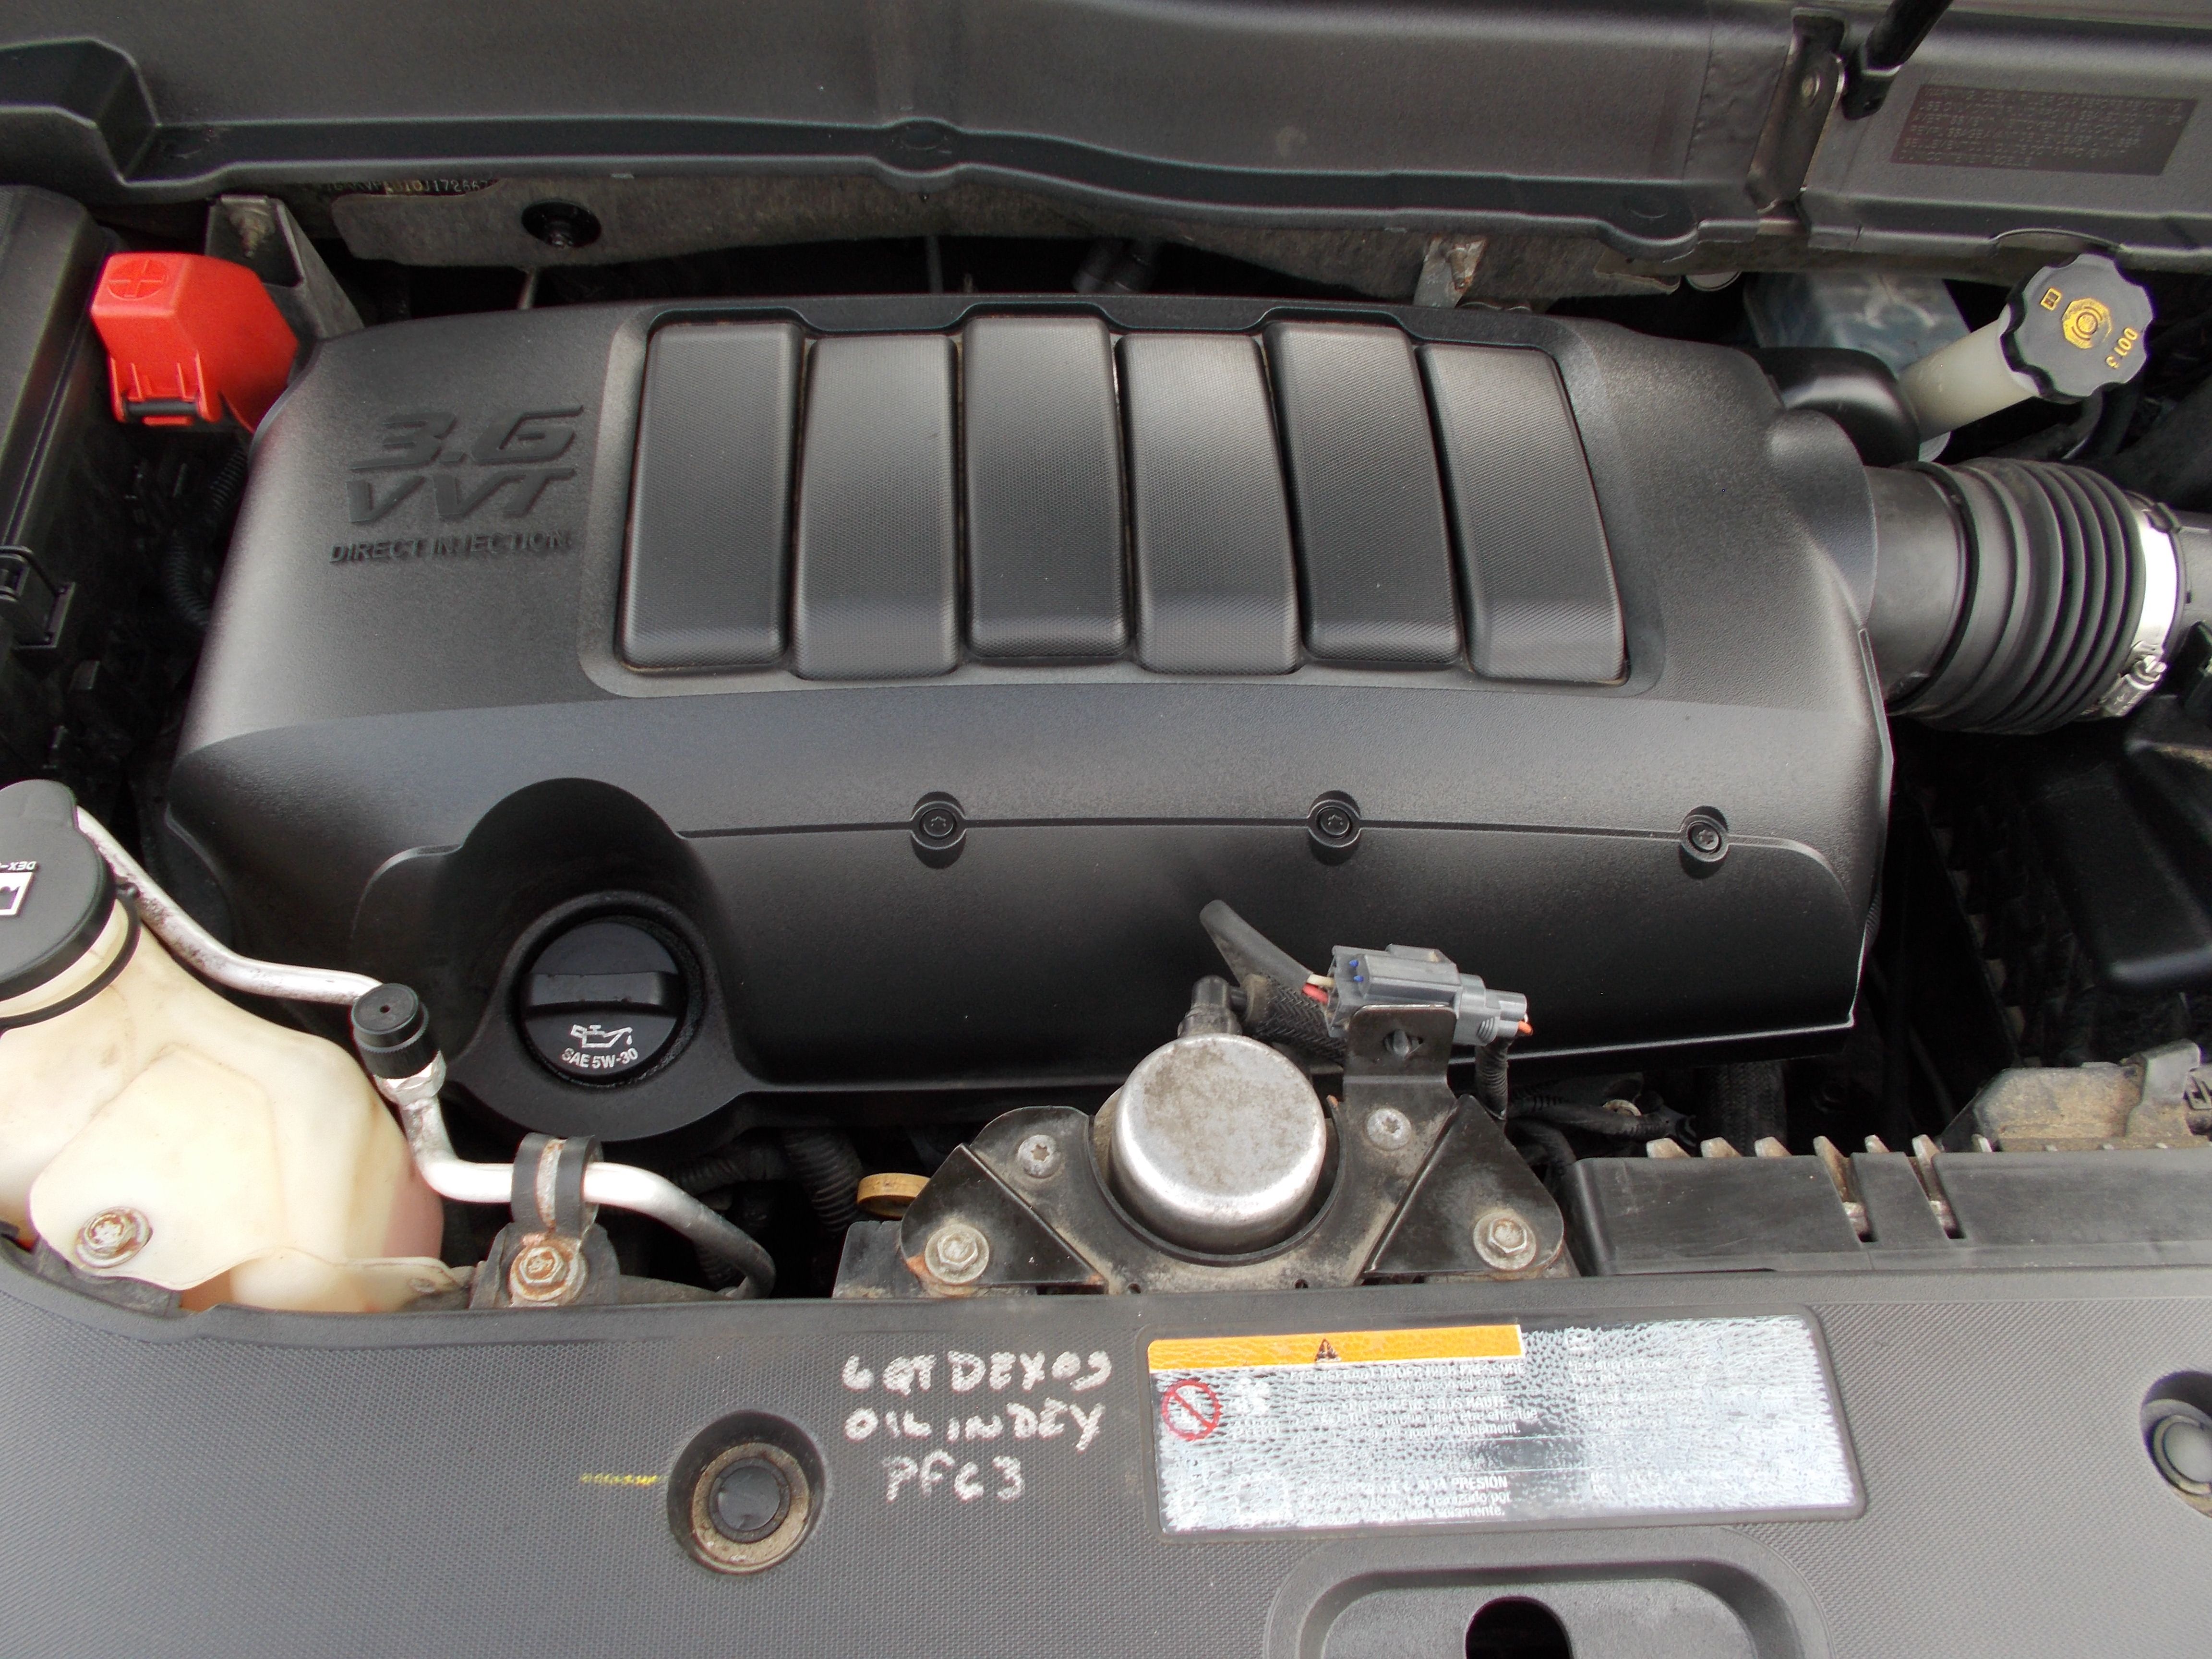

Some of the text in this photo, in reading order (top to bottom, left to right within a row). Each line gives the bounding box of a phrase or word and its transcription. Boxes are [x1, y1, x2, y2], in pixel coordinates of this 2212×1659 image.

[349, 405, 584, 471] 3.6
[346, 468, 577, 523] VVT
[329, 529, 572, 564] DIRECT INJECTION
[561, 1047, 638, 1069] SAE 5W-30
[844, 1407, 932, 1442] OIL
